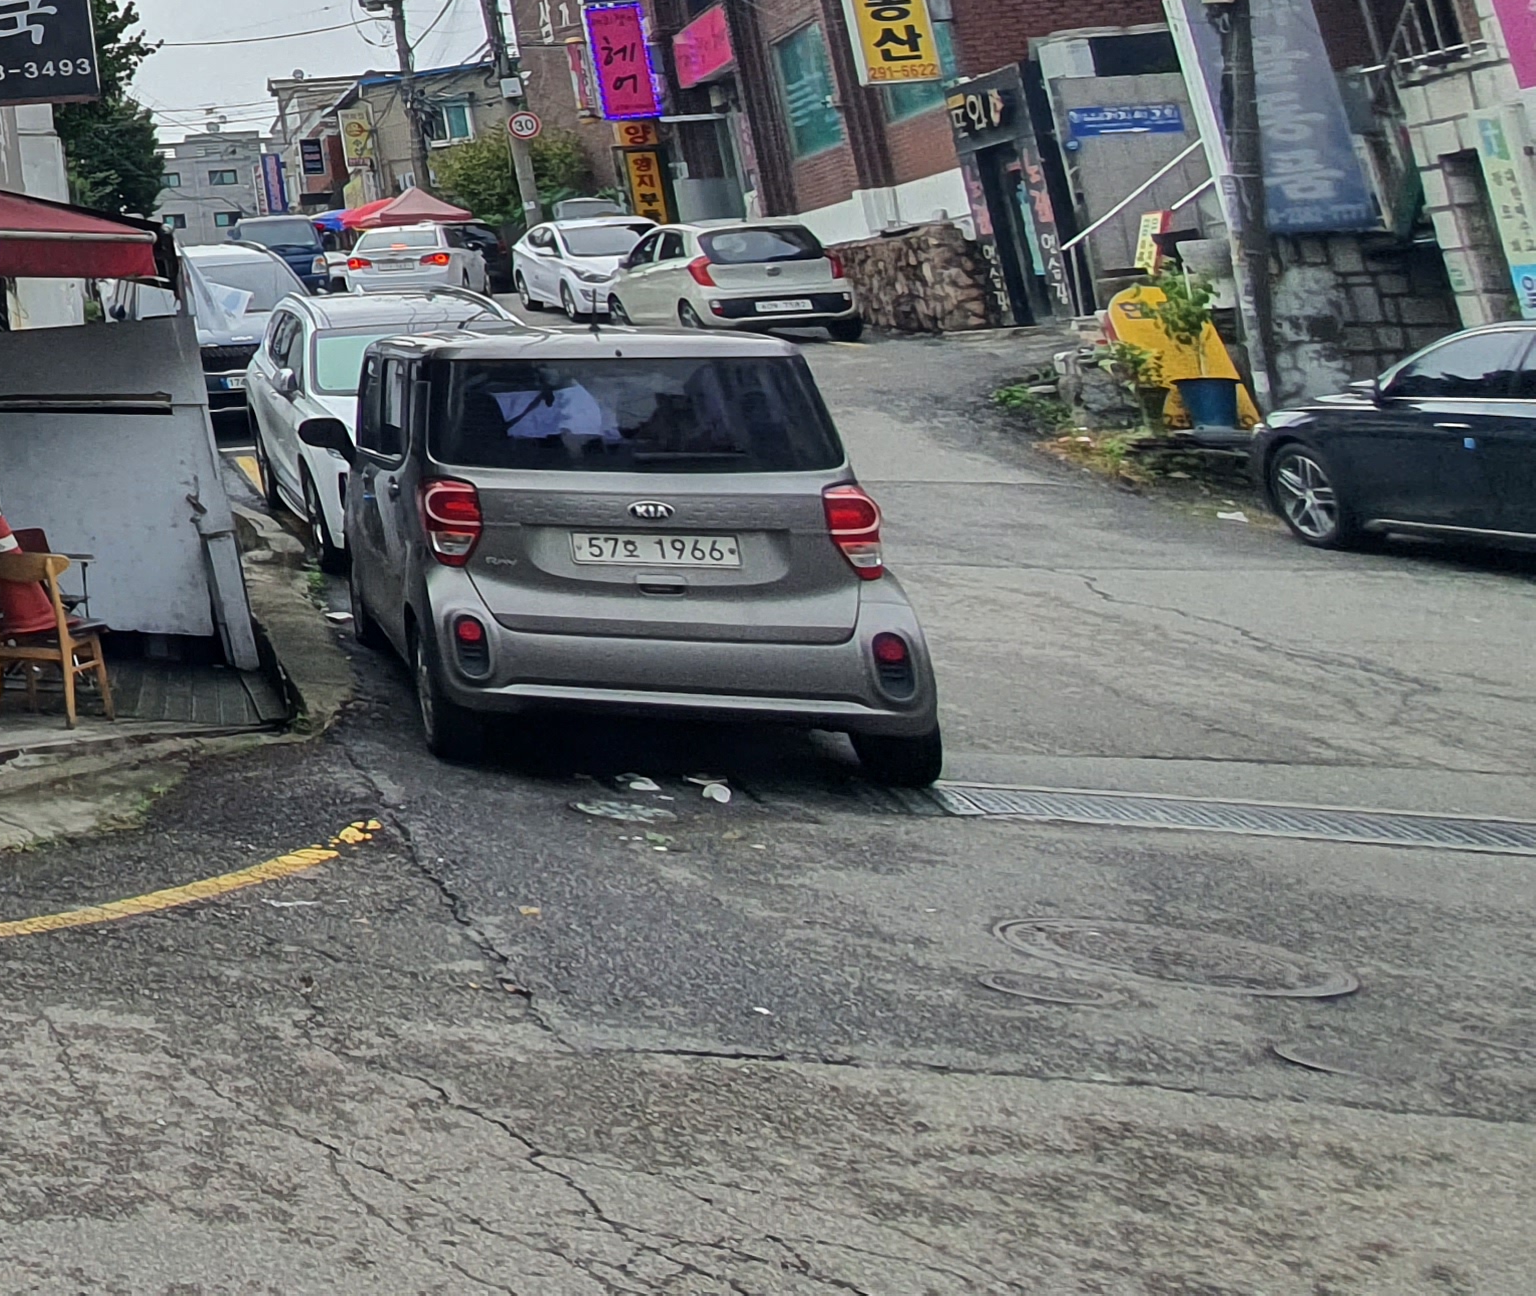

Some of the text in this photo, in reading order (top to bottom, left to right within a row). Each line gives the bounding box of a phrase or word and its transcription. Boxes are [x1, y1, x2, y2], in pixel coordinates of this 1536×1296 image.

[515, 119, 534, 132] 30
[636, 505, 668, 517] KIA
[587, 537, 724, 561] 57호 1966
